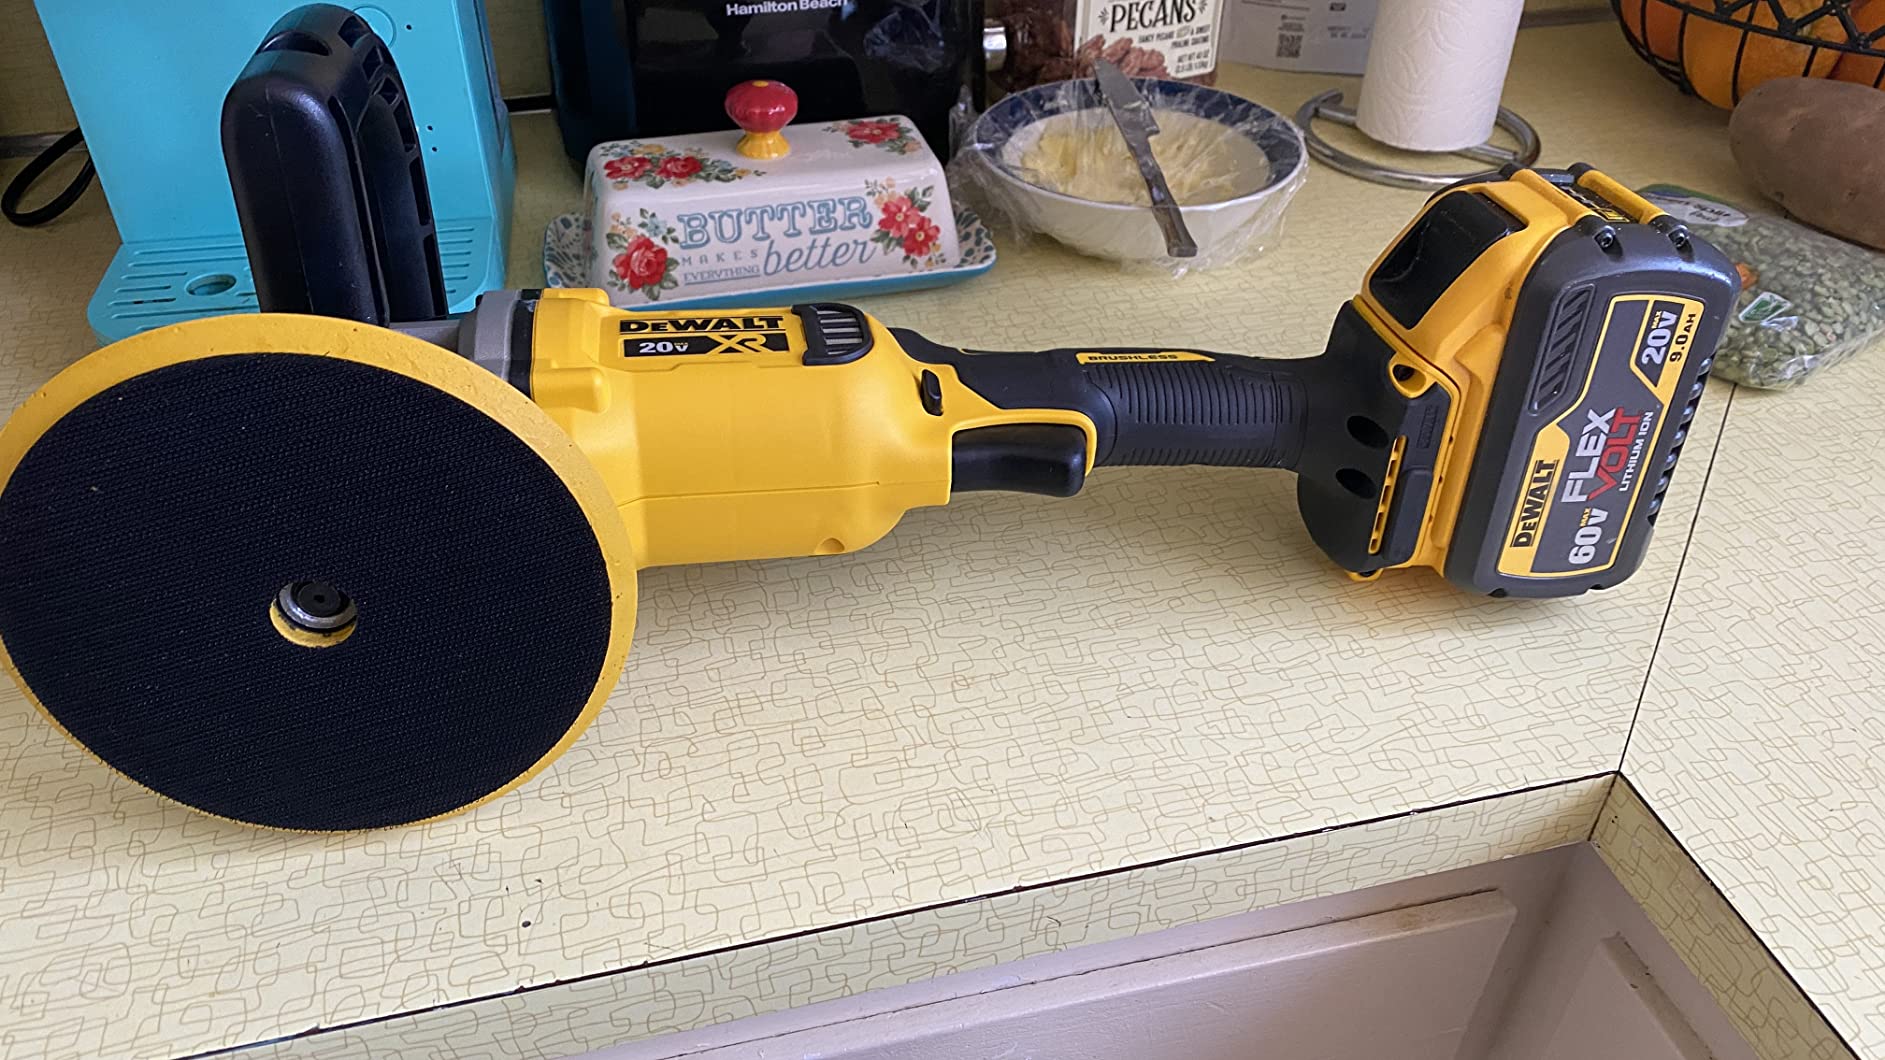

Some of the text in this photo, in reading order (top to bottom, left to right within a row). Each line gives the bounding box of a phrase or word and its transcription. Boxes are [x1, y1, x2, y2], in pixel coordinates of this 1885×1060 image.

[726, 0, 847, 16] Hamilton Beach
[1110, 0, 1196, 32] PECANS
[678, 196, 872, 249] BUTTER
[682, 249, 758, 266] MAKES
[683, 265, 761, 283] EVERYTHING
[763, 236, 879, 277] better
[1651, 310, 1662, 328] MAX
[706, 333, 773, 353] XR
[1642, 311, 1677, 365] 20V
[1561, 408, 1616, 503] FLEX
[1587, 406, 1642, 500] VOLT
[1619, 412, 1654, 492] LITHIUM ION
[1579, 507, 1591, 528] MAX
[1568, 508, 1608, 565] 60V
